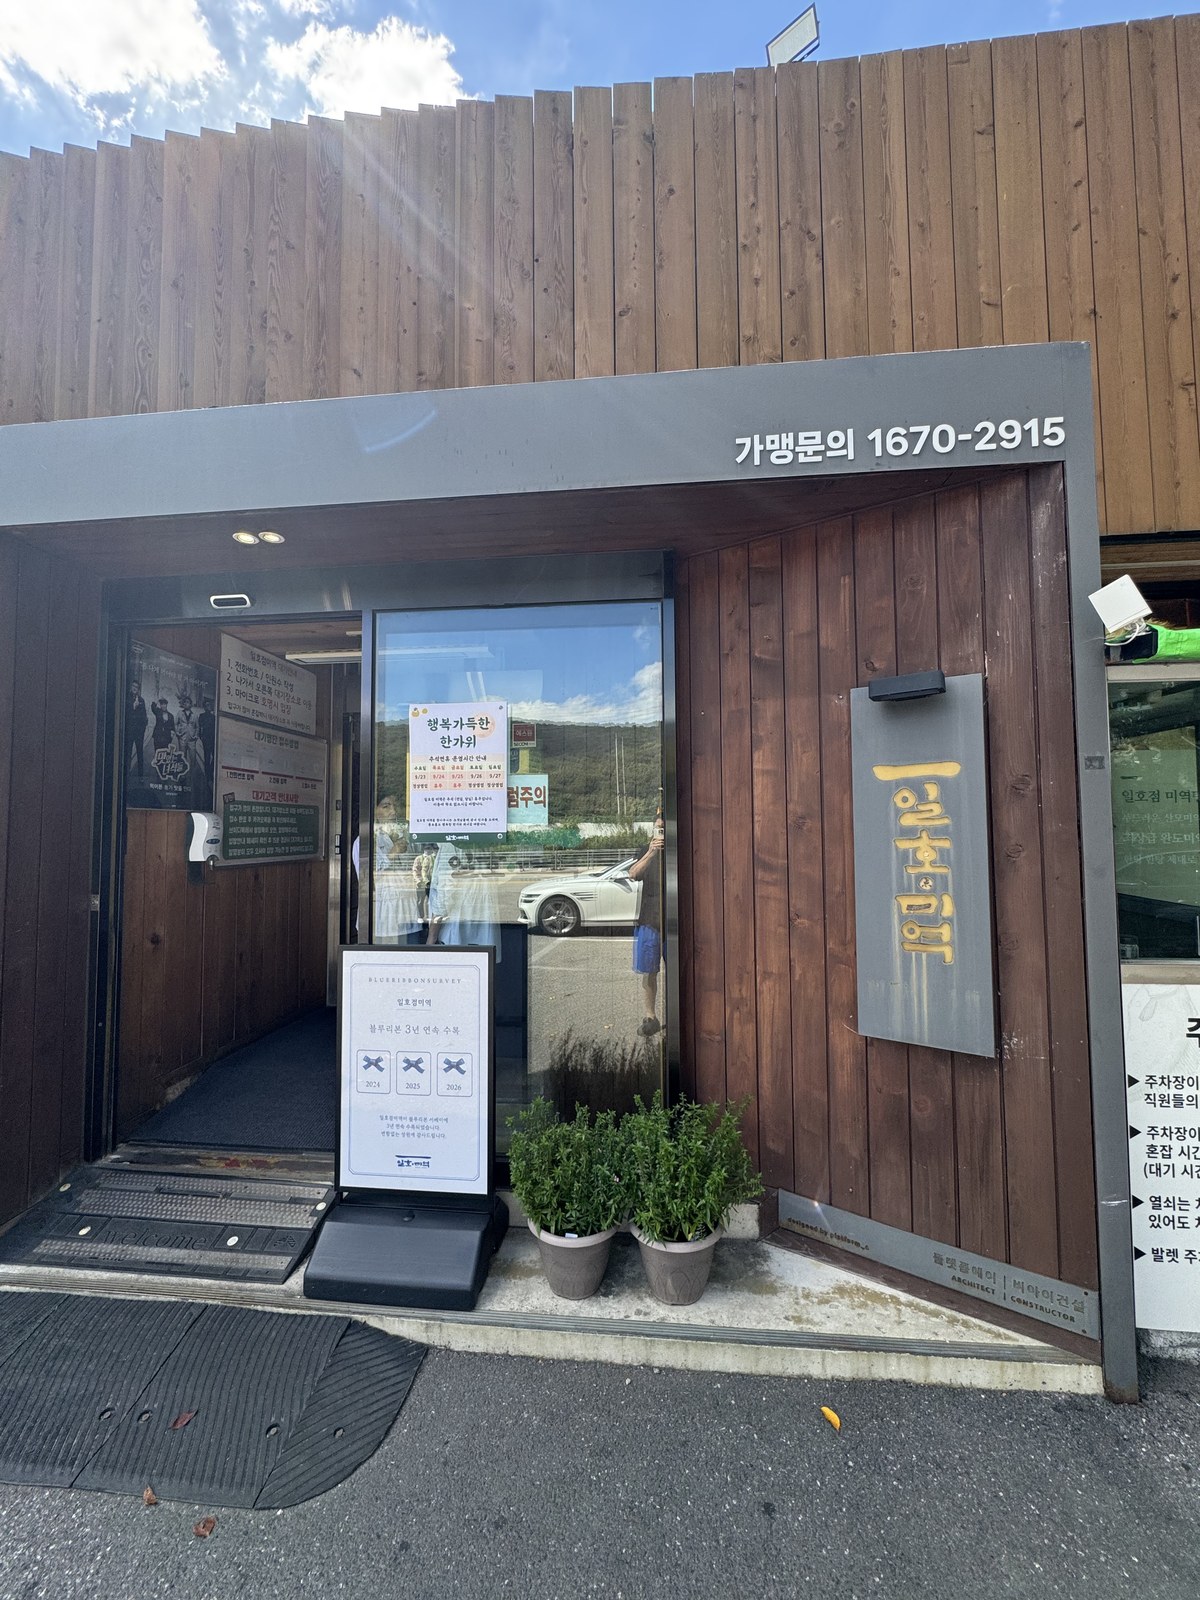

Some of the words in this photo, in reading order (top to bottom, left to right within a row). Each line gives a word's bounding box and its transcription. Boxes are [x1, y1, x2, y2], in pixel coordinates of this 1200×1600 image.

[735, 428, 855, 466] 가맹문의
[866, 416, 1066, 457] 1670-2915
[235, 661, 259, 678] 전화번호
[236, 676, 254, 690] 나가서
[256, 683, 272, 697] 오른쪽
[235, 689, 260, 704] 마이크로
[440, 735, 476, 748] 한가위
[370, 1024, 402, 1034] 블루리본
[405, 1024, 420, 1034] 3년
[423, 1025, 440, 1035] 연속
[443, 1026, 460, 1036] 수록
[1144, 1093, 1199, 1108] 직원들의
[1146, 1144, 1172, 1159] 혼잡
[1143, 1162, 1176, 1178] (대기
[1149, 1196, 1190, 1211] 열쇠는
[1148, 1214, 1190, 1230] 있어도
[102, 1227, 208, 1251] welcome
[1151, 1248, 1179, 1264] 발렛
[951, 1274, 996, 1295] ARCHITECT
[1010, 1296, 1076, 1323] CONSTRUCTOR
